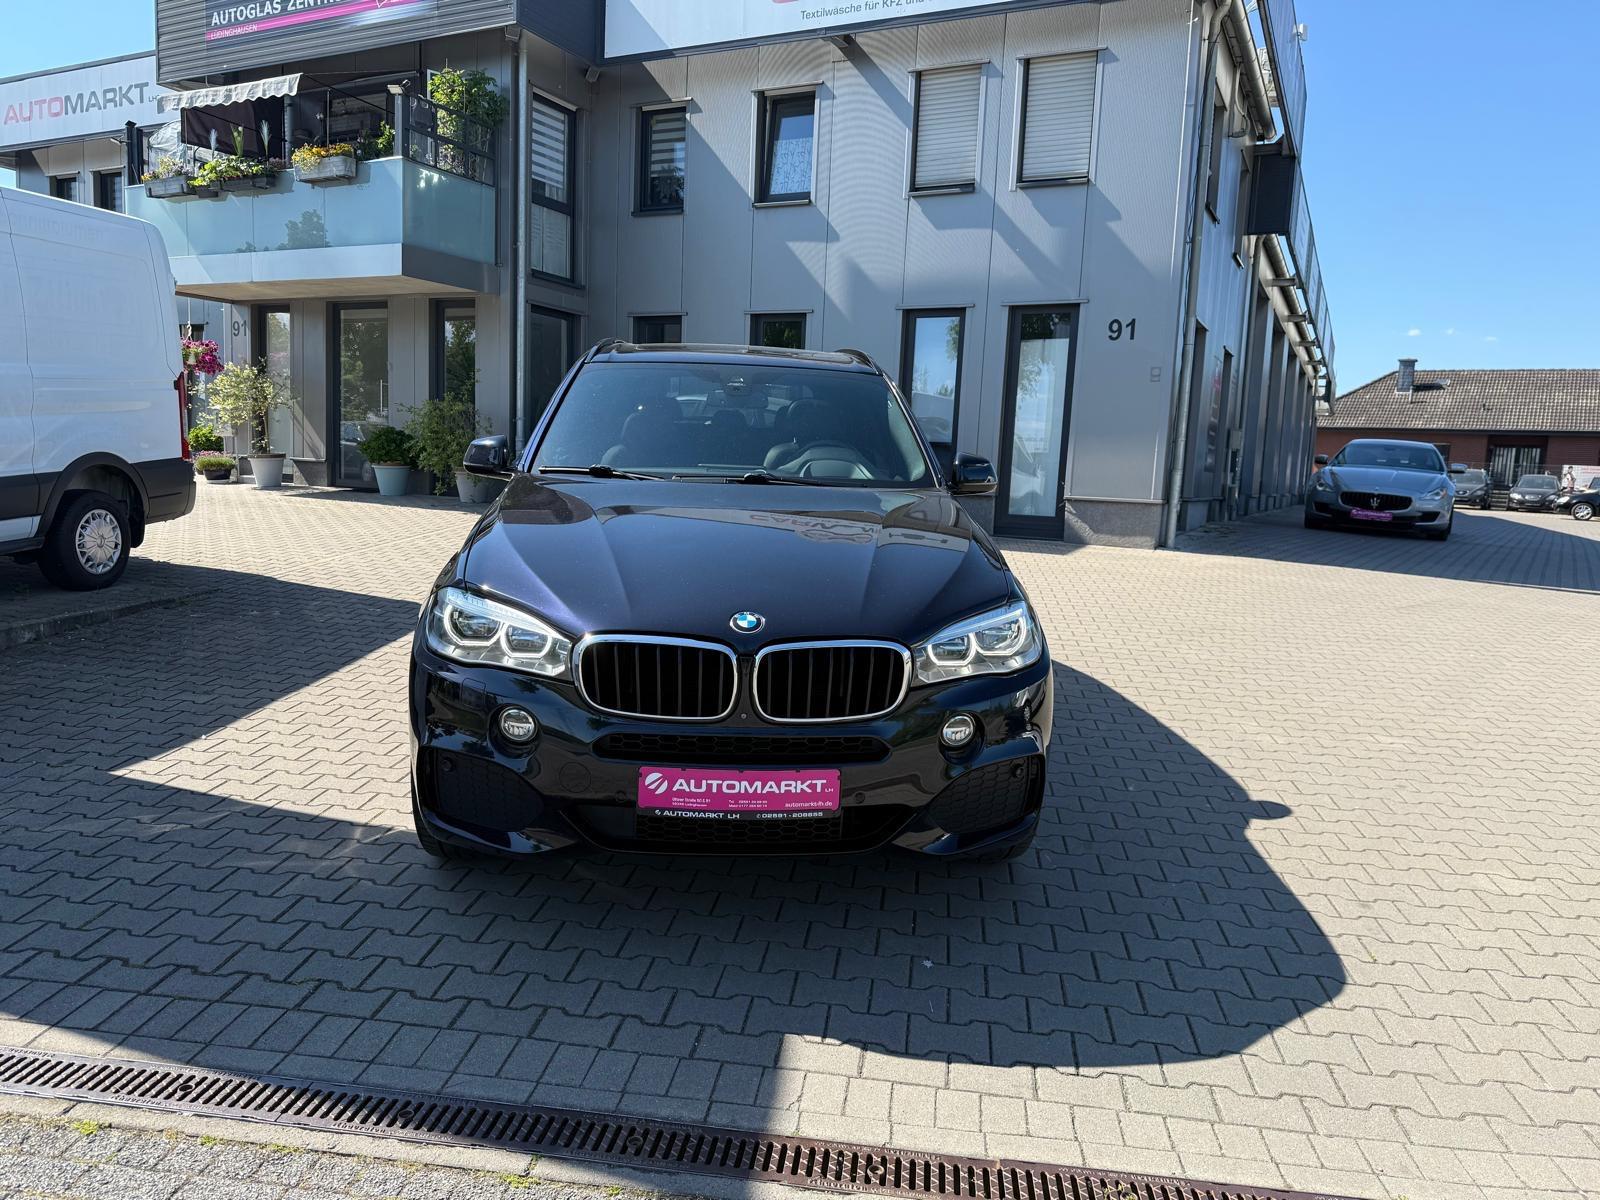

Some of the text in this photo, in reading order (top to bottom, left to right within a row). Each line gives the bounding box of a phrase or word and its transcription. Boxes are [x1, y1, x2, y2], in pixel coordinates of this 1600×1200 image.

[211, 0, 281, 26] AUTOGLAS
[864, 1, 879, 10] für
[4, 82, 149, 125] AUTOMARKT
[232, 320, 248, 337] 91
[1108, 318, 1136, 341] 91
[672, 779, 826, 794] AUTOMARKT
[663, 810, 724, 818] AUTOMARKT
